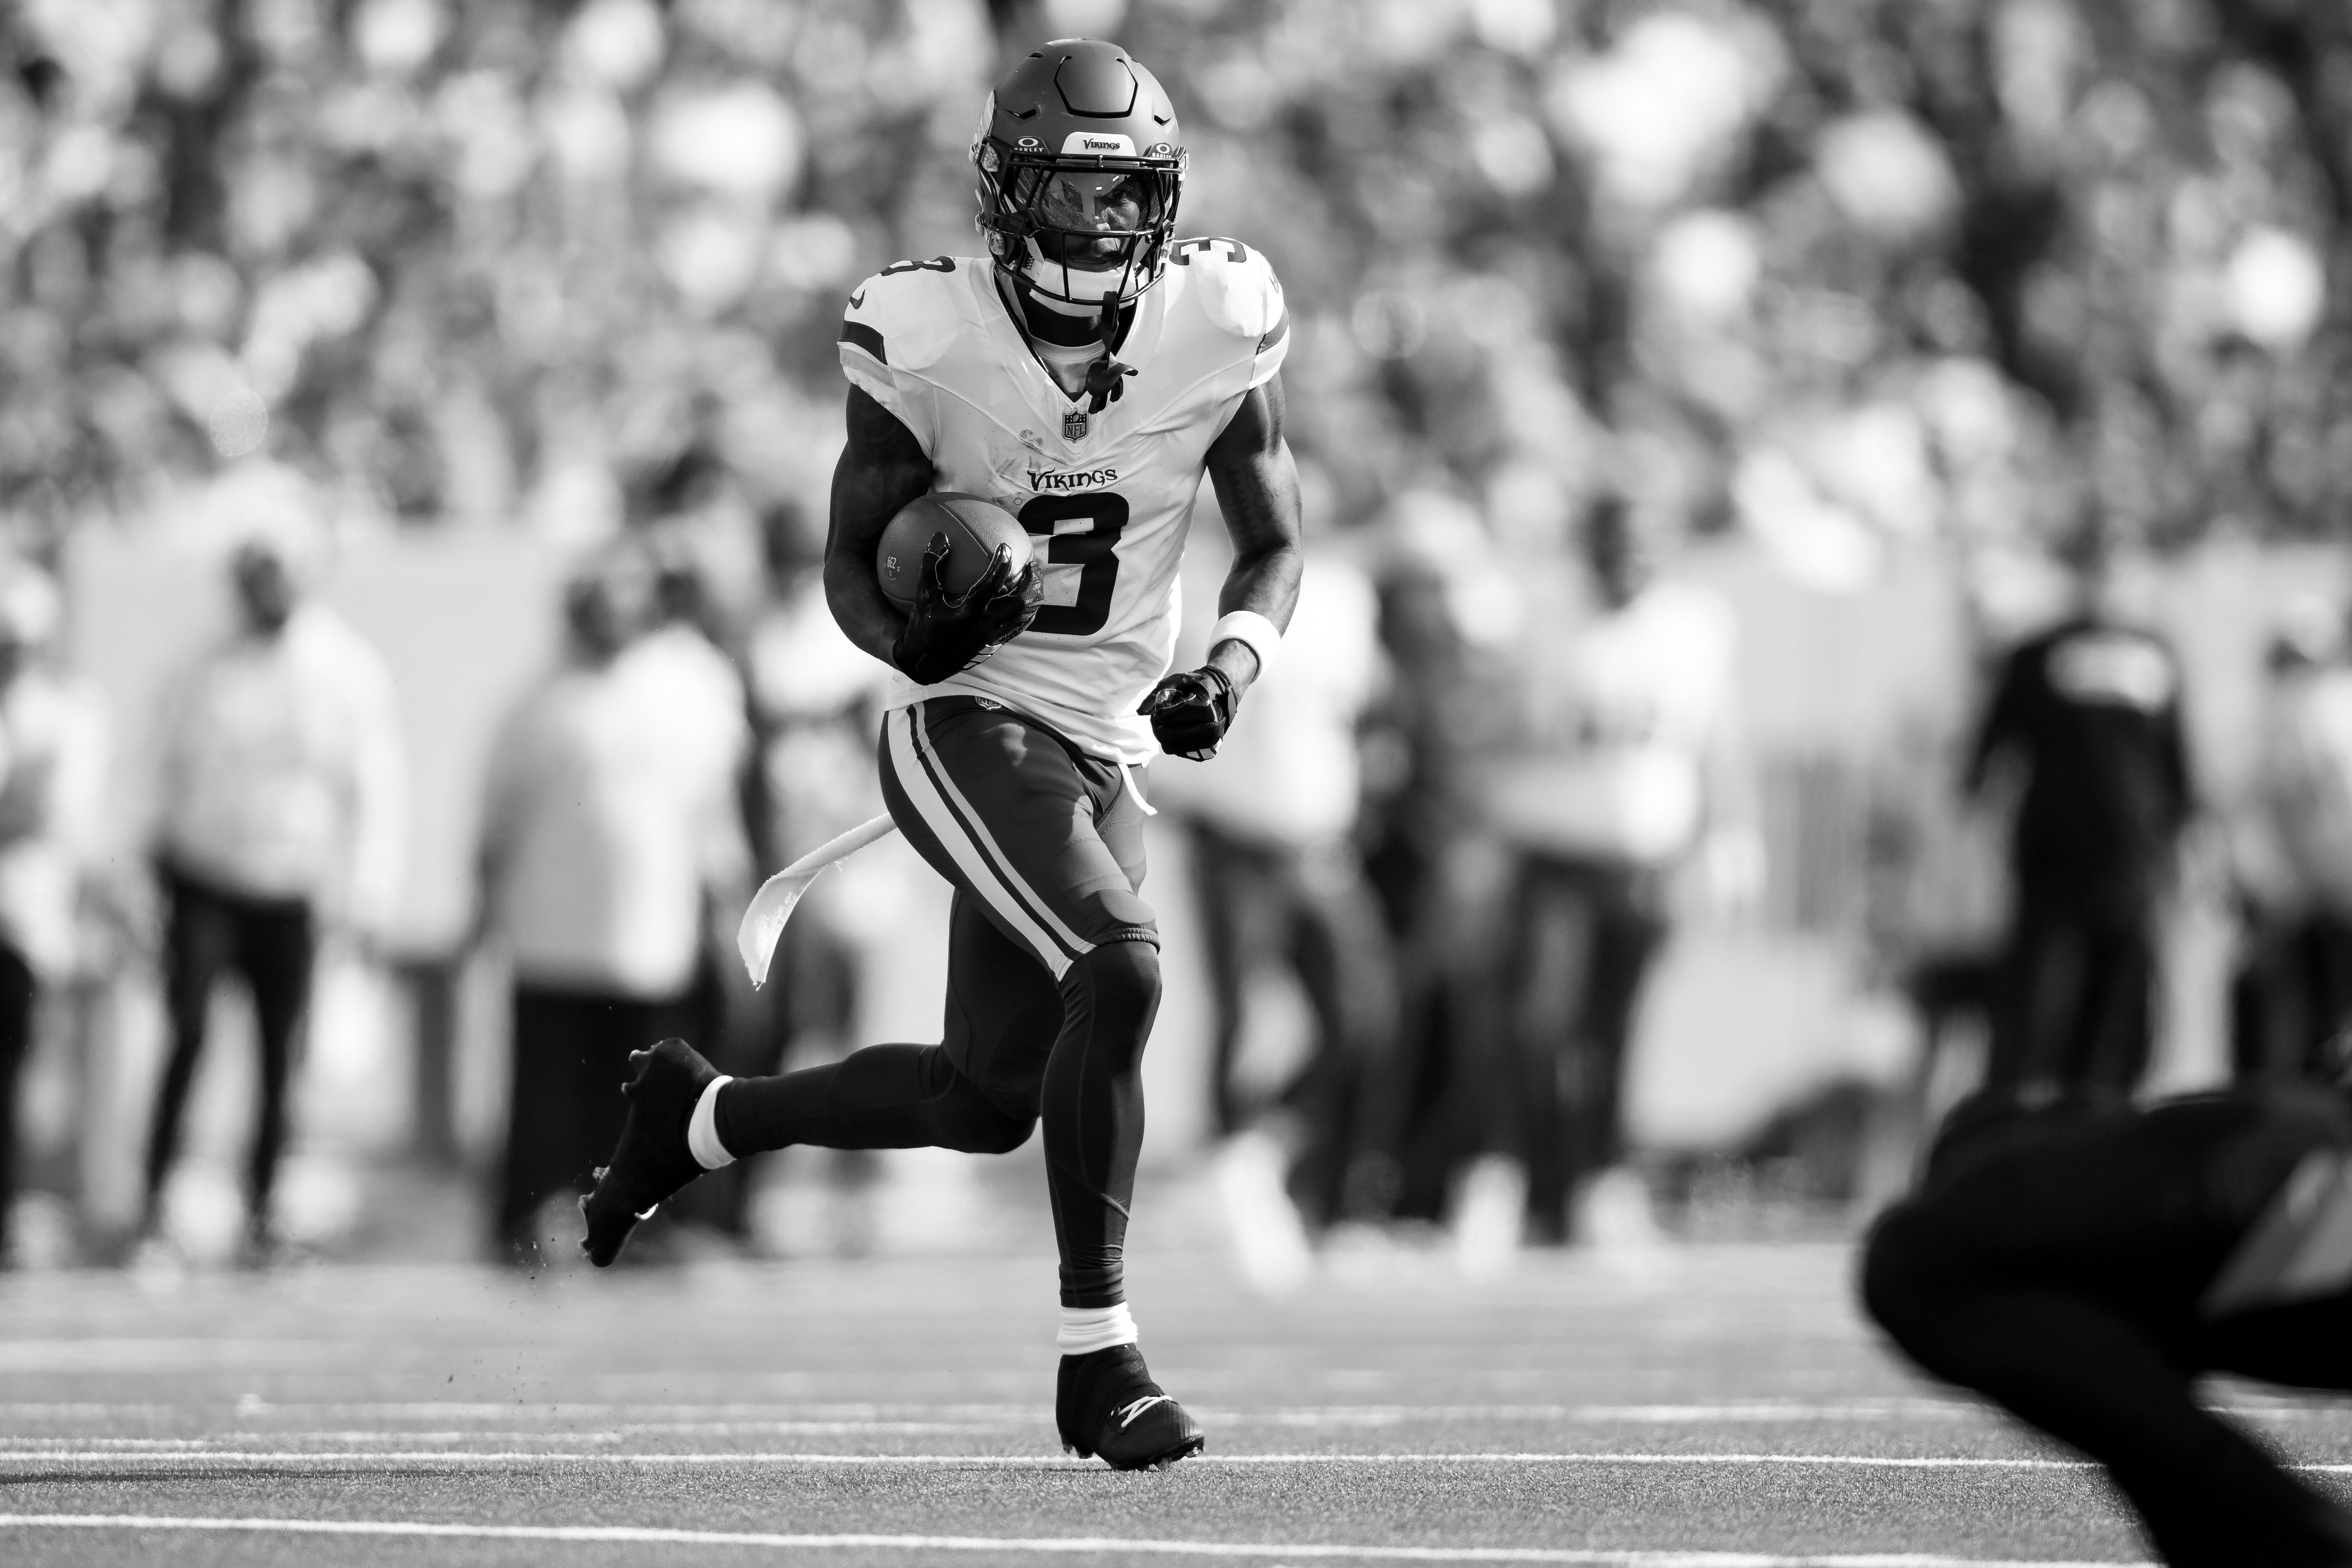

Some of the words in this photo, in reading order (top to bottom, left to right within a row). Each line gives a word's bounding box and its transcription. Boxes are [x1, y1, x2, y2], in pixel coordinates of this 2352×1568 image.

[1067, 424, 1085, 437] NFL
[1027, 467, 1118, 491] VIKINGS
[887, 556, 896, 569] 239
[1017, 492, 1130, 636] 3
